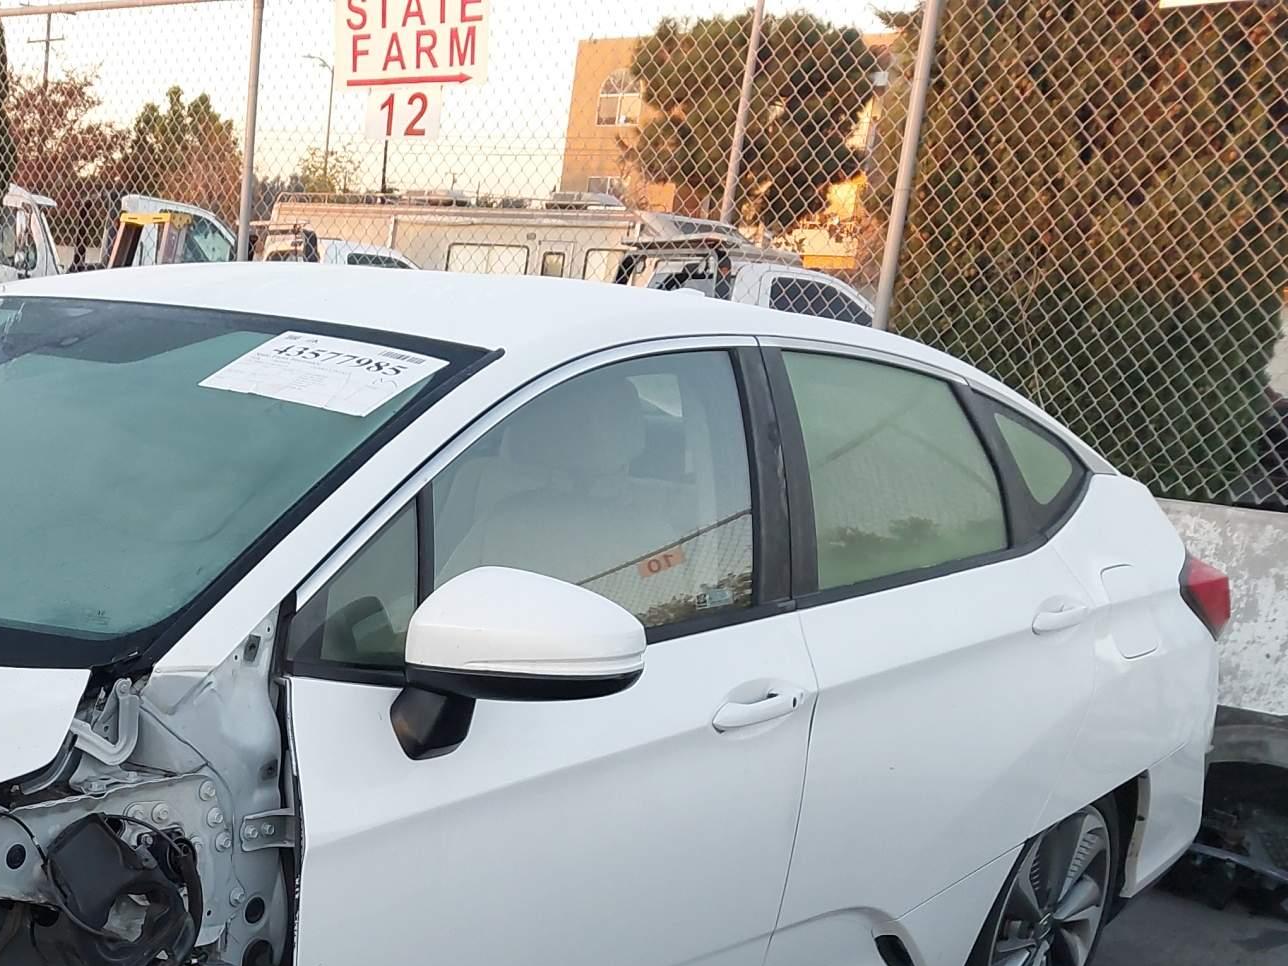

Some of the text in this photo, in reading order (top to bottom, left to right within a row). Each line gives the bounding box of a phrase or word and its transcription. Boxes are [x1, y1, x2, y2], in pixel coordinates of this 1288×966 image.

[352, 26, 477, 73] FARM
[380, 91, 429, 137] 12
[273, 344, 409, 376] 43577985
